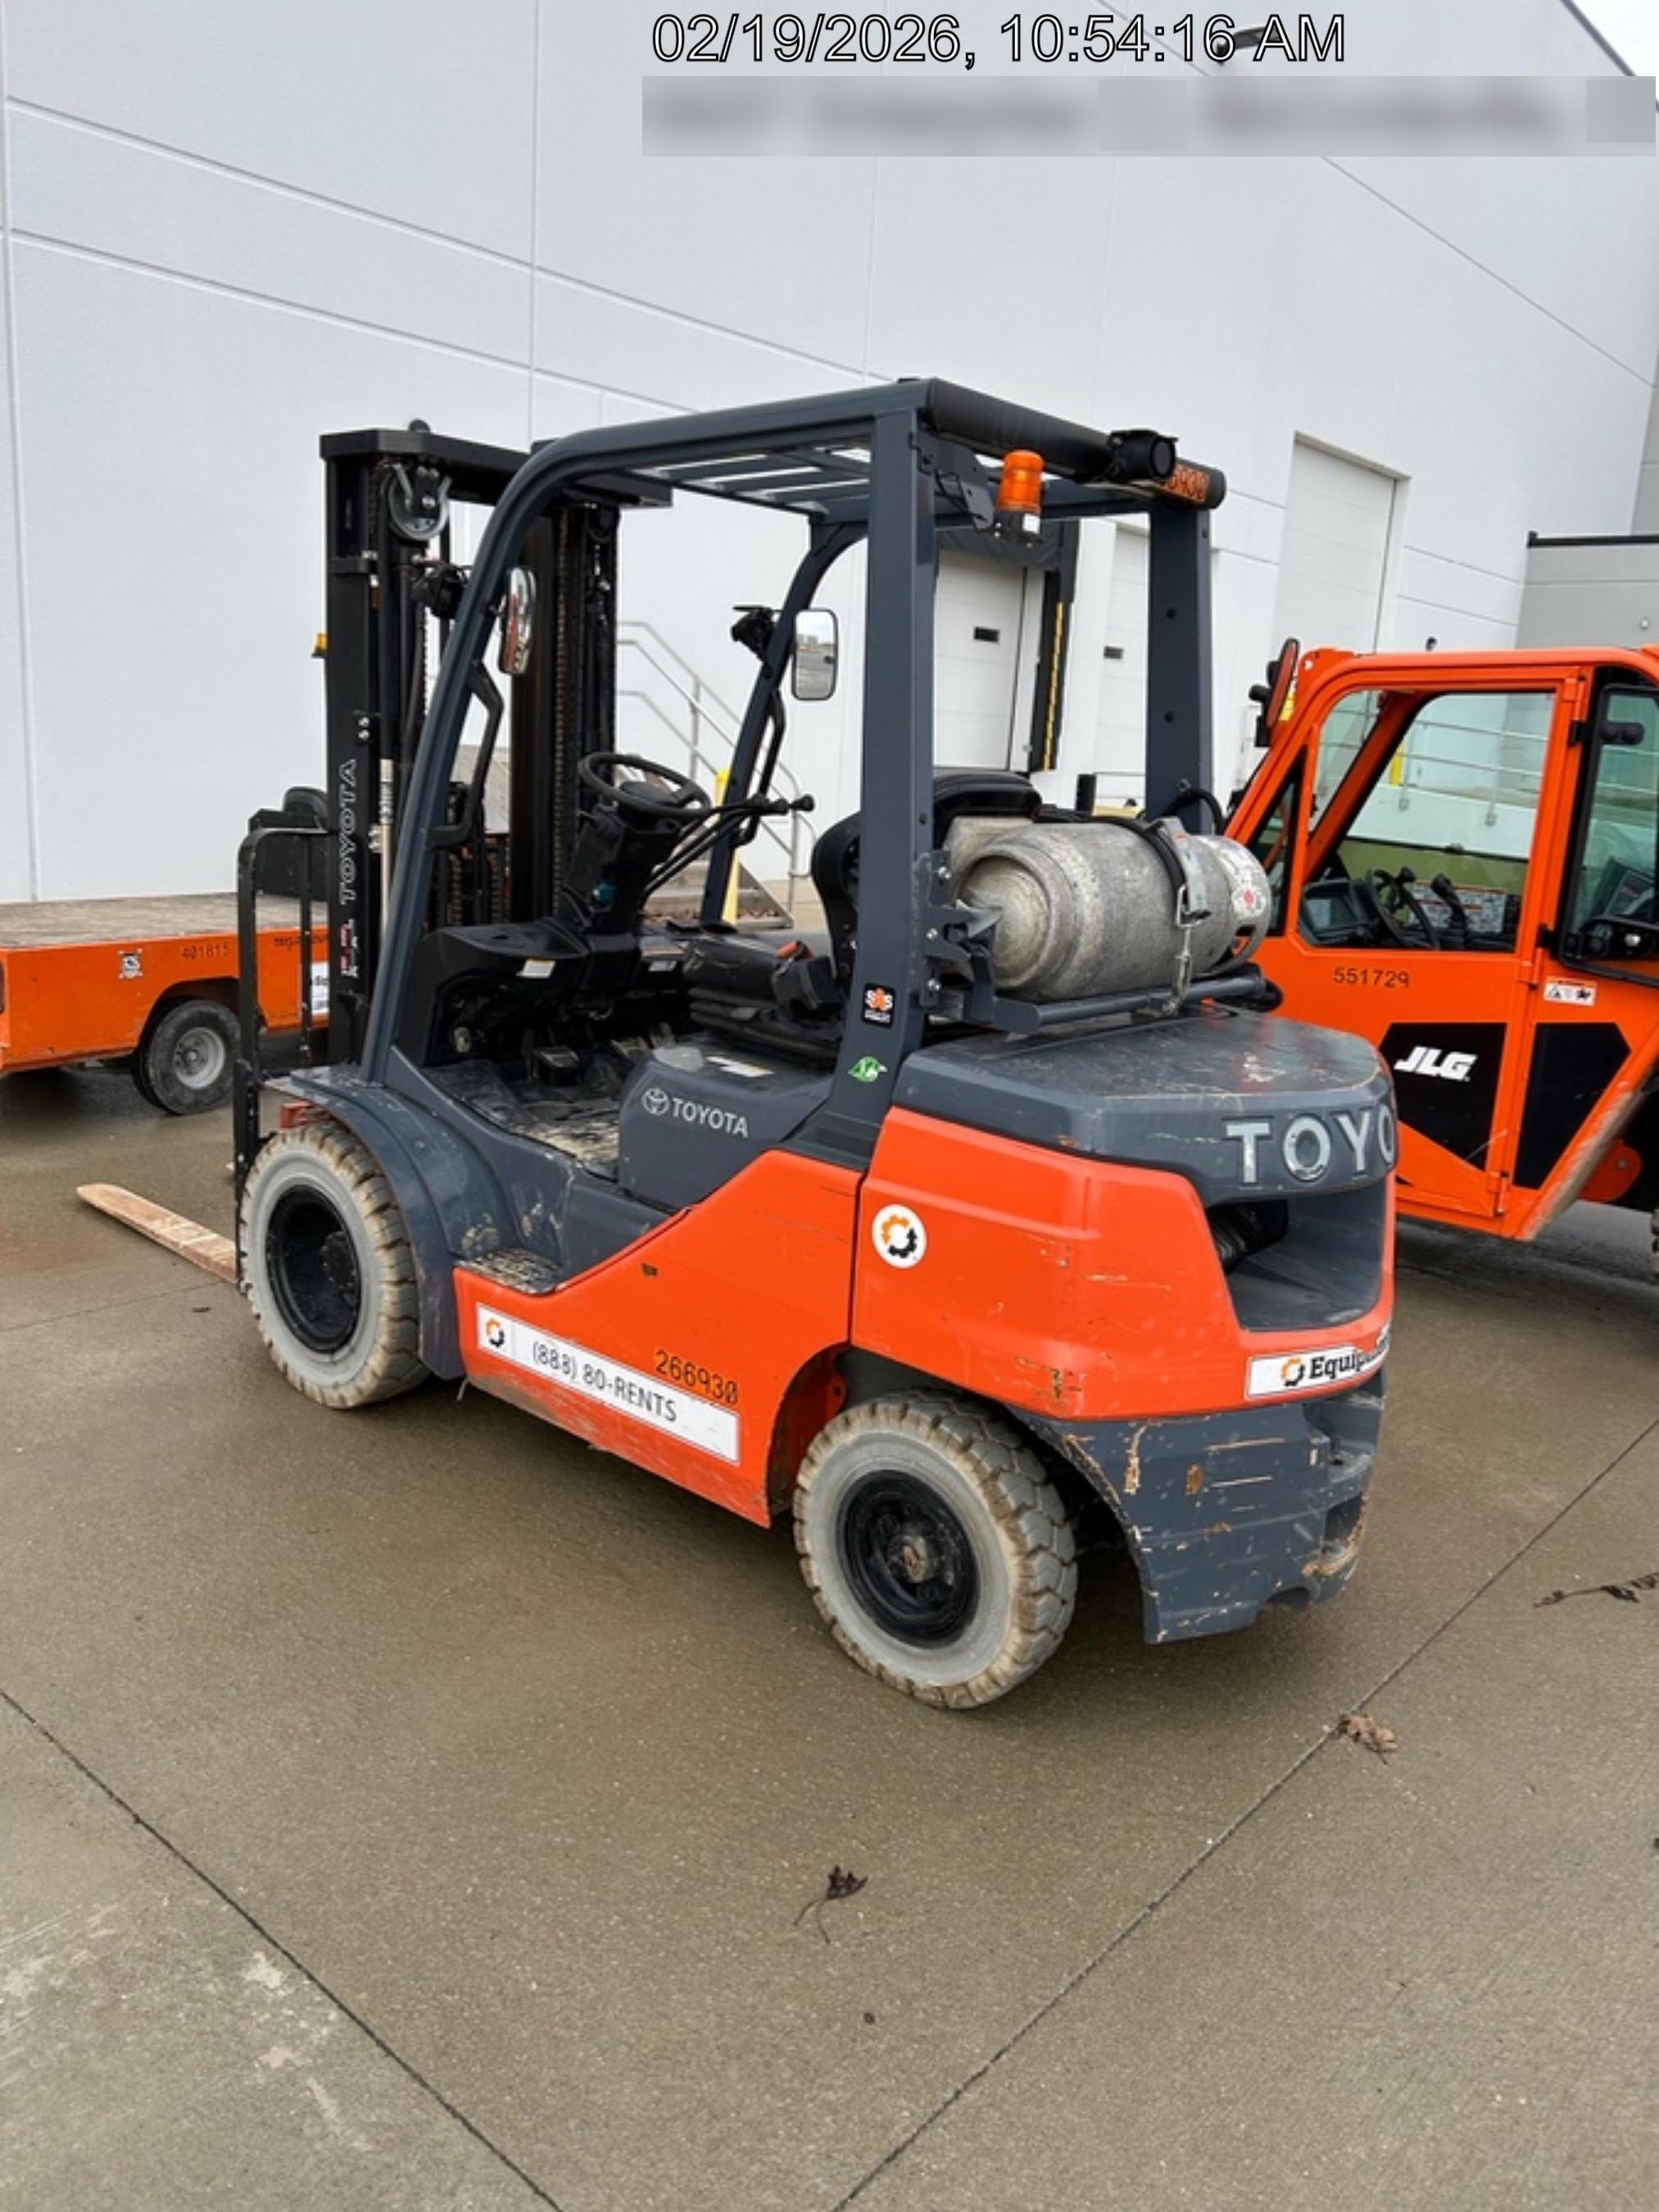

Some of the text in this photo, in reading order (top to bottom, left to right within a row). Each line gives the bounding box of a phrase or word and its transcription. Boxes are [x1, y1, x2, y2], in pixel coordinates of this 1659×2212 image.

[339, 759, 356, 904] TOYOTA
[1334, 966, 1409, 988] 551729
[1394, 1046, 1477, 1081] JLG
[673, 1097, 748, 1138] TOYOTA
[1226, 1104, 1395, 1183] TOYO
[582, 1363, 677, 1422] 80-RENTS
[655, 1350, 738, 1406] 266930
